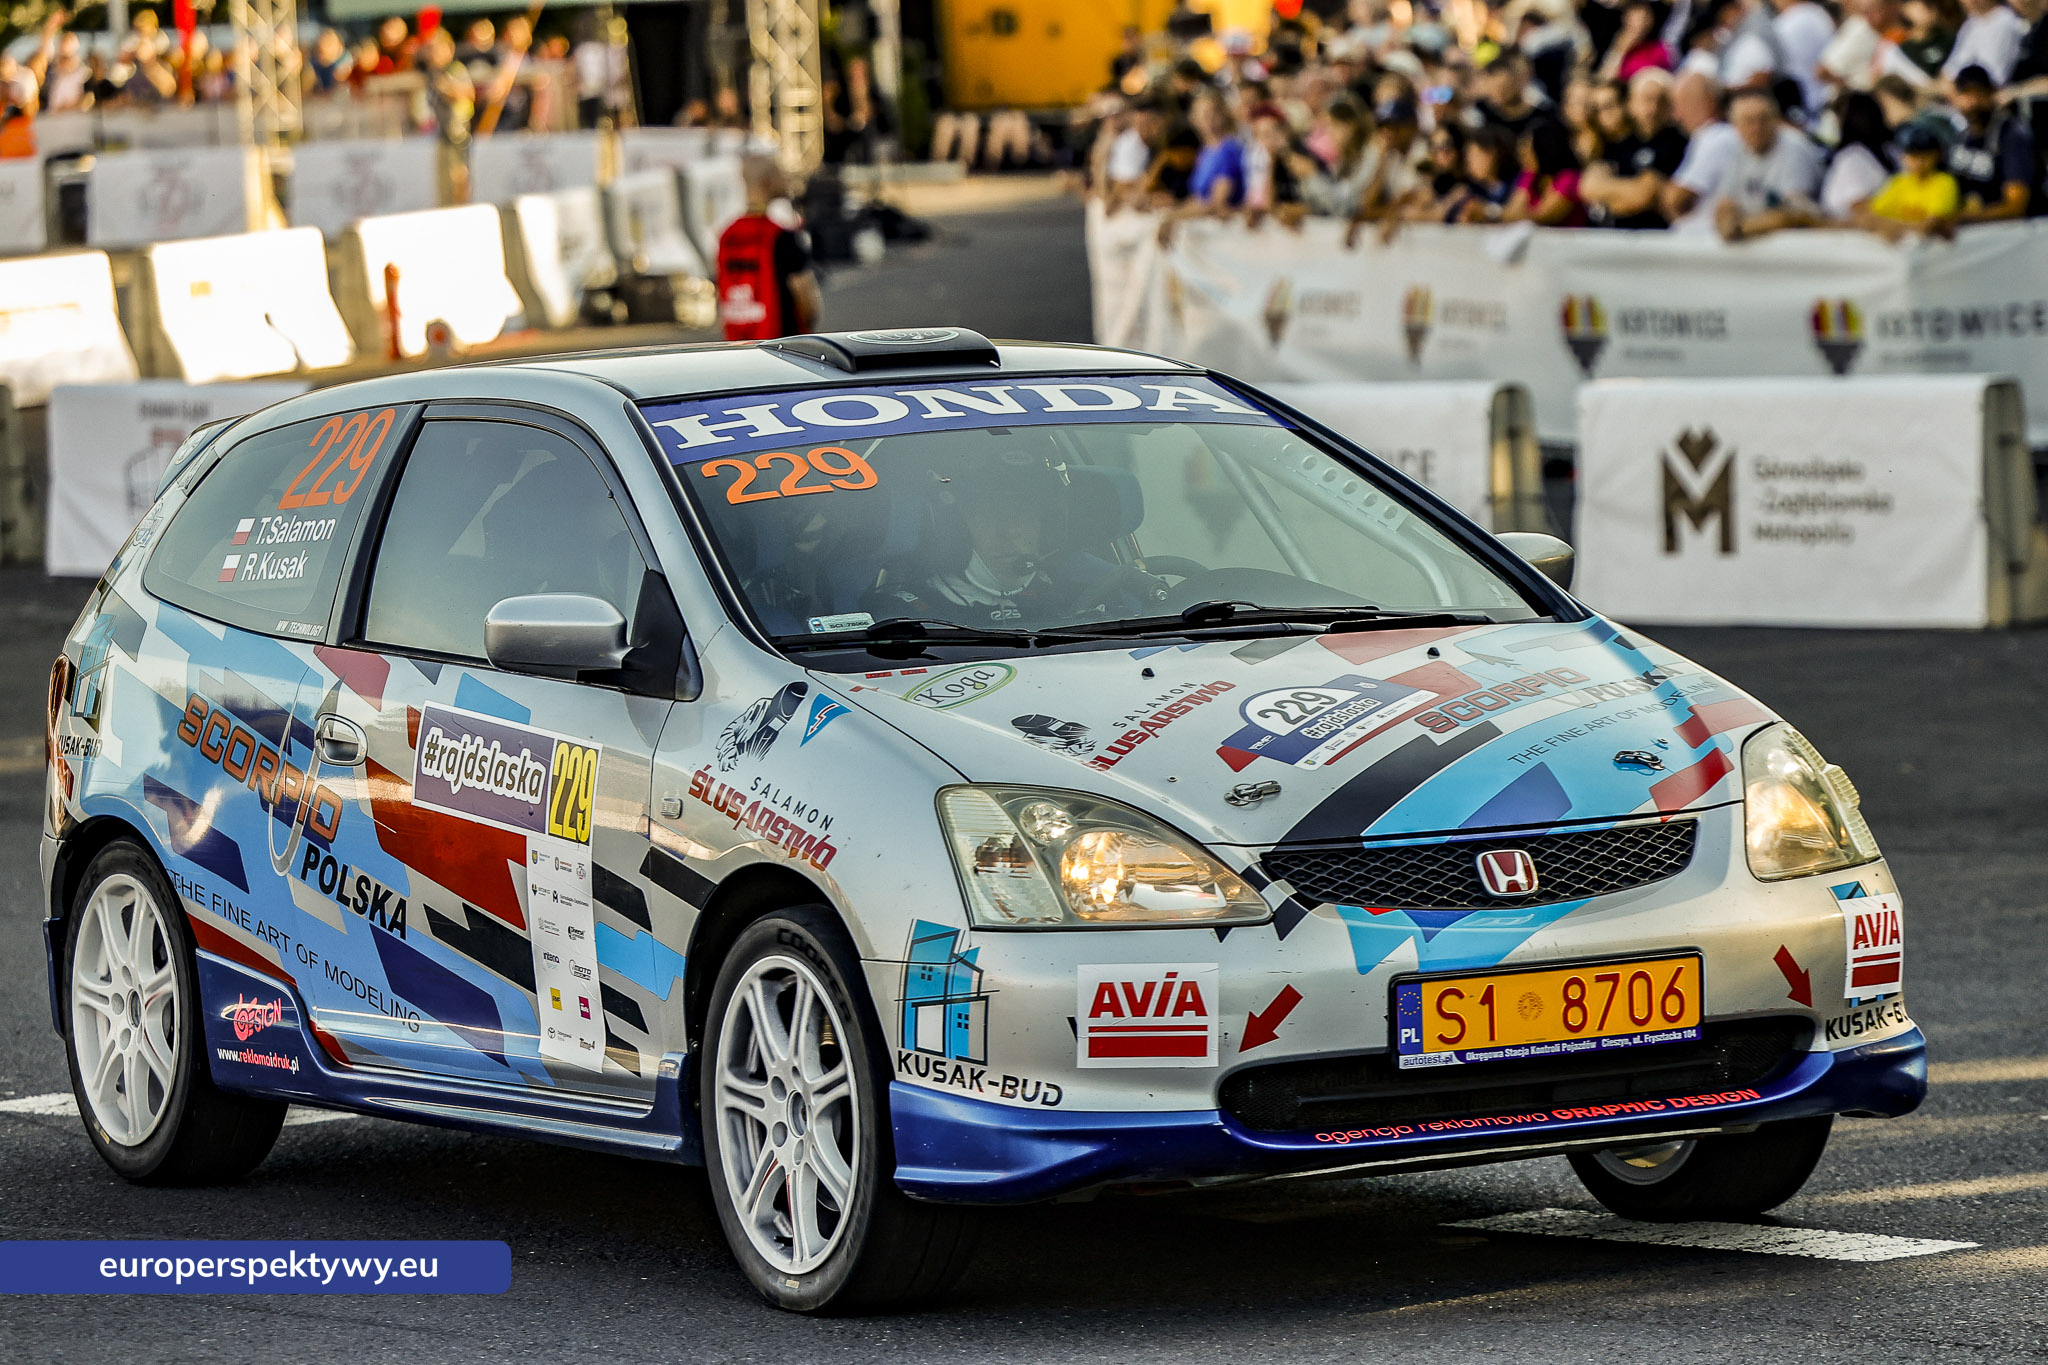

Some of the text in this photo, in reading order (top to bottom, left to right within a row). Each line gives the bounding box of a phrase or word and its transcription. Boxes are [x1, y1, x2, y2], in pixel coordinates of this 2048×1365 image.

[653, 383, 1268, 449] HONDA
[277, 408, 396, 510] 229
[701, 446, 878, 505] 229
[255, 514, 336, 545] T.Salamon
[240, 550, 308, 581] R.Kusak
[914, 668, 995, 707] Koga
[1112, 682, 1197, 728] SALAMON
[1257, 691, 1338, 725] 229
[1414, 667, 1590, 733] SCORPIO
[1585, 664, 1684, 701] POLSKA
[1303, 698, 1379, 739] #rajdslaska
[1508, 680, 1720, 766] THE FINE ART OF MODELING
[177, 692, 343, 843] SCORPIO
[424, 733, 544, 798] #rajdslaska
[549, 742, 597, 843] 229
[750, 776, 835, 832] SALAMON
[301, 842, 408, 940] POLSKA
[169, 869, 206, 906] THE
[212, 892, 252, 933] FINE
[256, 920, 291, 953] ART
[296, 943, 319, 969] OF
[324, 959, 421, 1033] MODELING
[1436, 966, 1686, 1045] S1 8706
[217, 1048, 300, 1075] www.reklamaidruk.pl
[1400, 1028, 1421, 1044] PL
[1403, 1054, 1454, 1067] autotest.pl
[1504, 1047, 1530, 1057] Stacja
[1530, 1042, 1561, 1055] Kontroli
[1561, 1040, 1597, 1053] Pojazdów
[898, 1050, 1064, 1107] KUSAK-BUD
[1315, 1088, 1762, 1145] agencja reklamowa GRAPHIC DESIGN
